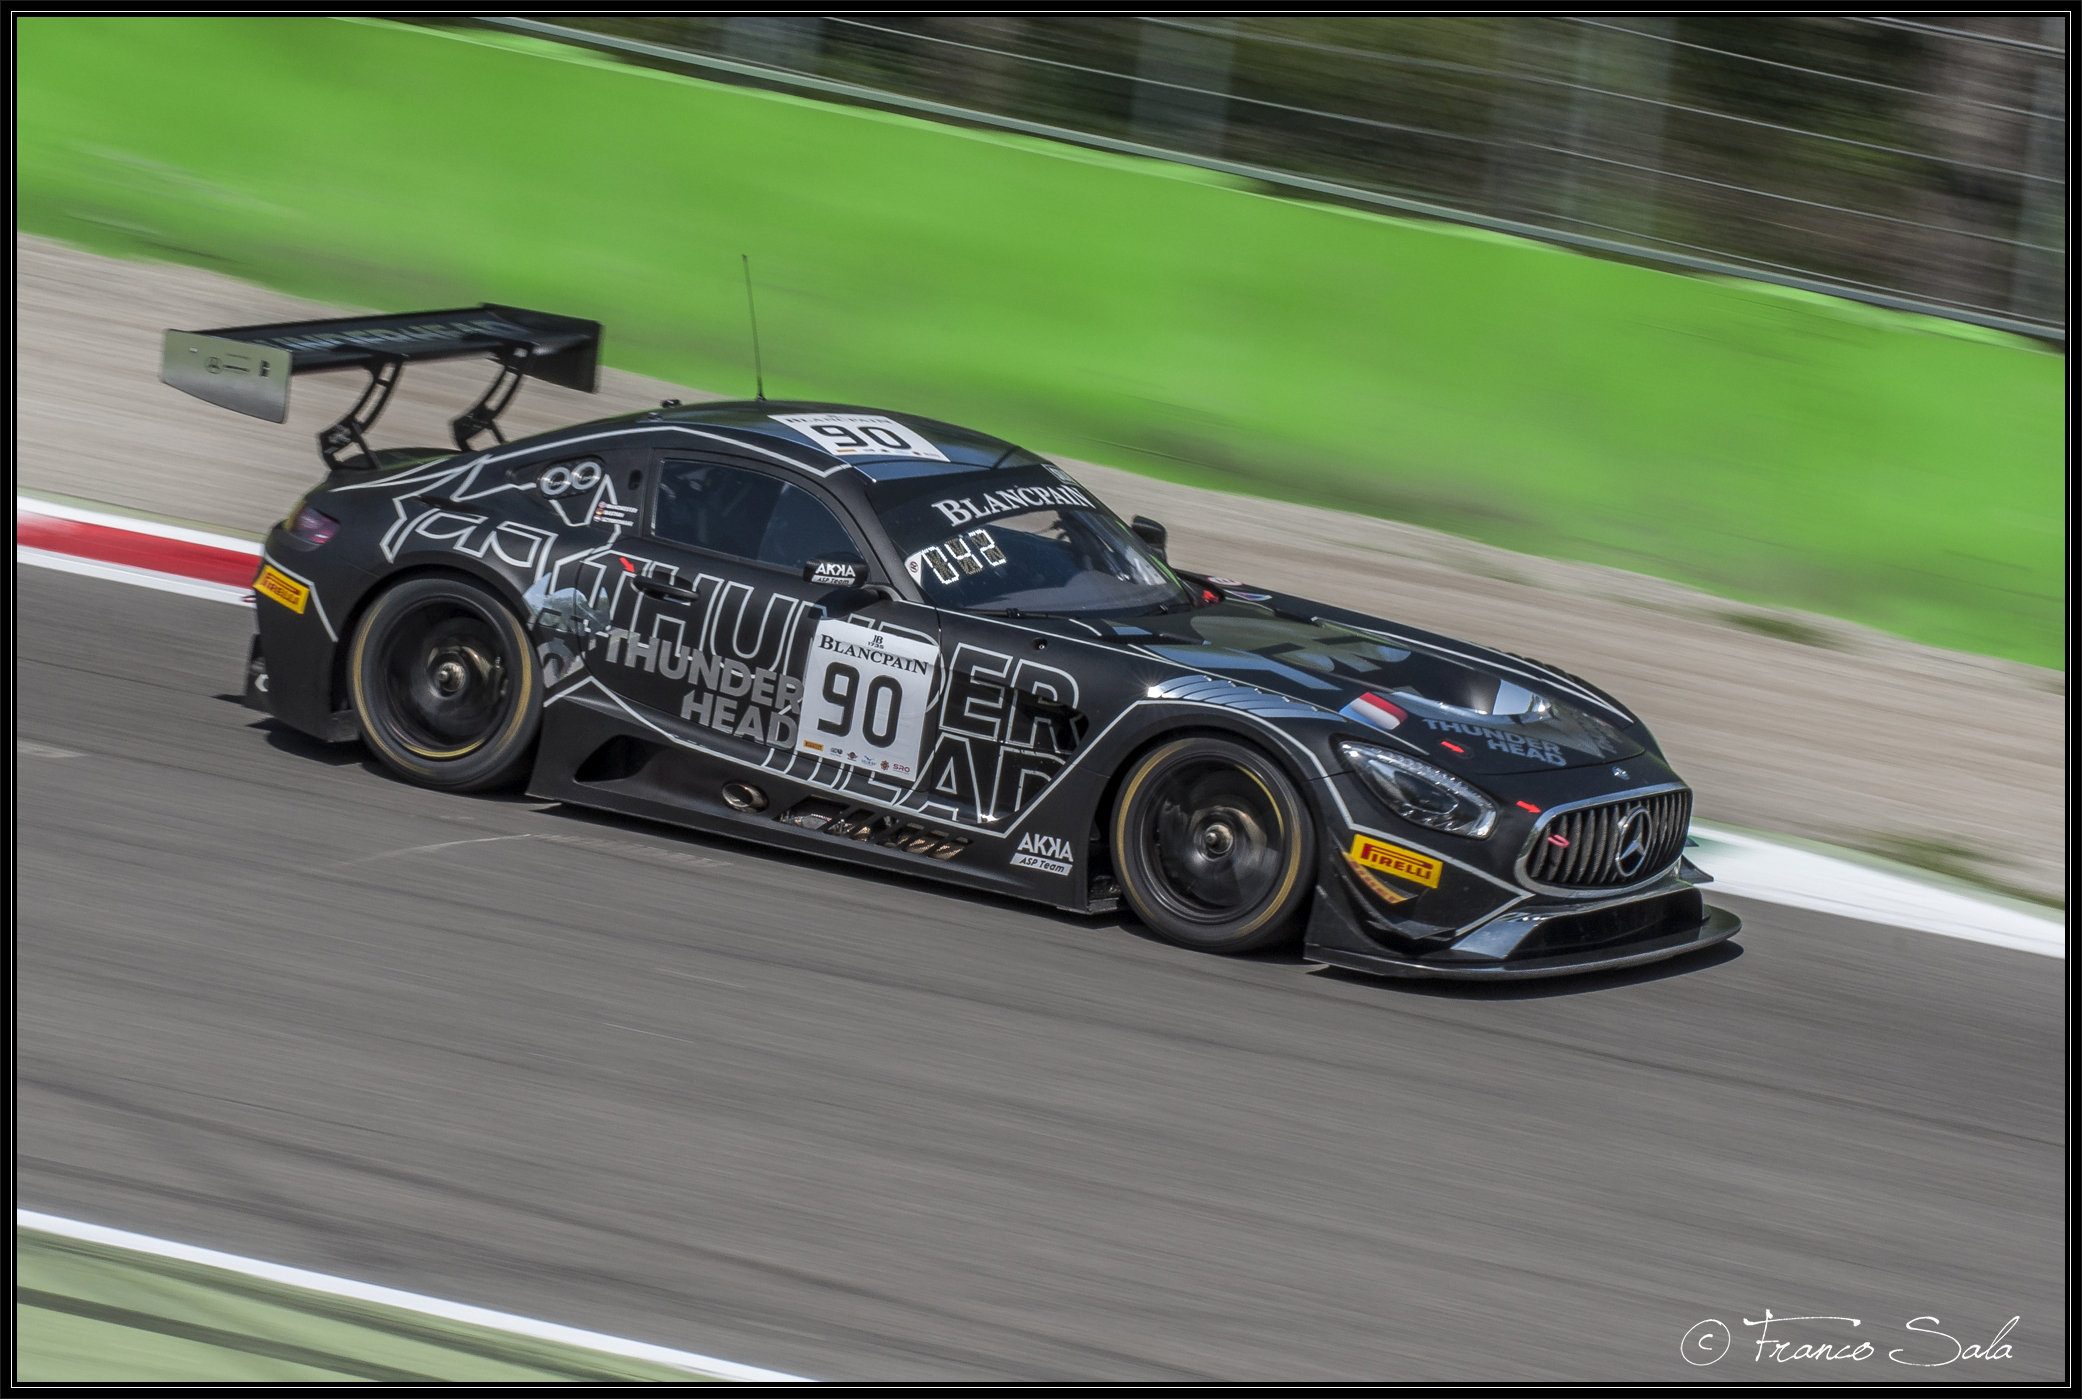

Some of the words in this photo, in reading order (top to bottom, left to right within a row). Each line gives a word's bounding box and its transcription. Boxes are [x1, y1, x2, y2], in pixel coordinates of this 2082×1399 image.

[810, 424, 912, 450] 90
[931, 484, 1096, 527] BLANCPAIN
[815, 562, 857, 577] AKKA
[920, 528, 1007, 585] 042
[262, 572, 301, 605] PIRELLI
[818, 633, 929, 676] BLANCPAIN
[867, 641, 885, 650] 1735
[606, 626, 804, 714] THUNDER
[680, 689, 798, 749] HEAD
[817, 661, 903, 748] 90
[1422, 718, 1563, 756] THUNDER
[1487, 739, 1567, 767] HEAD
[892, 762, 911, 773] SRO
[1017, 832, 1074, 862] AKKA
[1360, 843, 1434, 879] PIRELLI
[1019, 857, 1038, 866] ASP
[1039, 860, 1065, 873] Team
